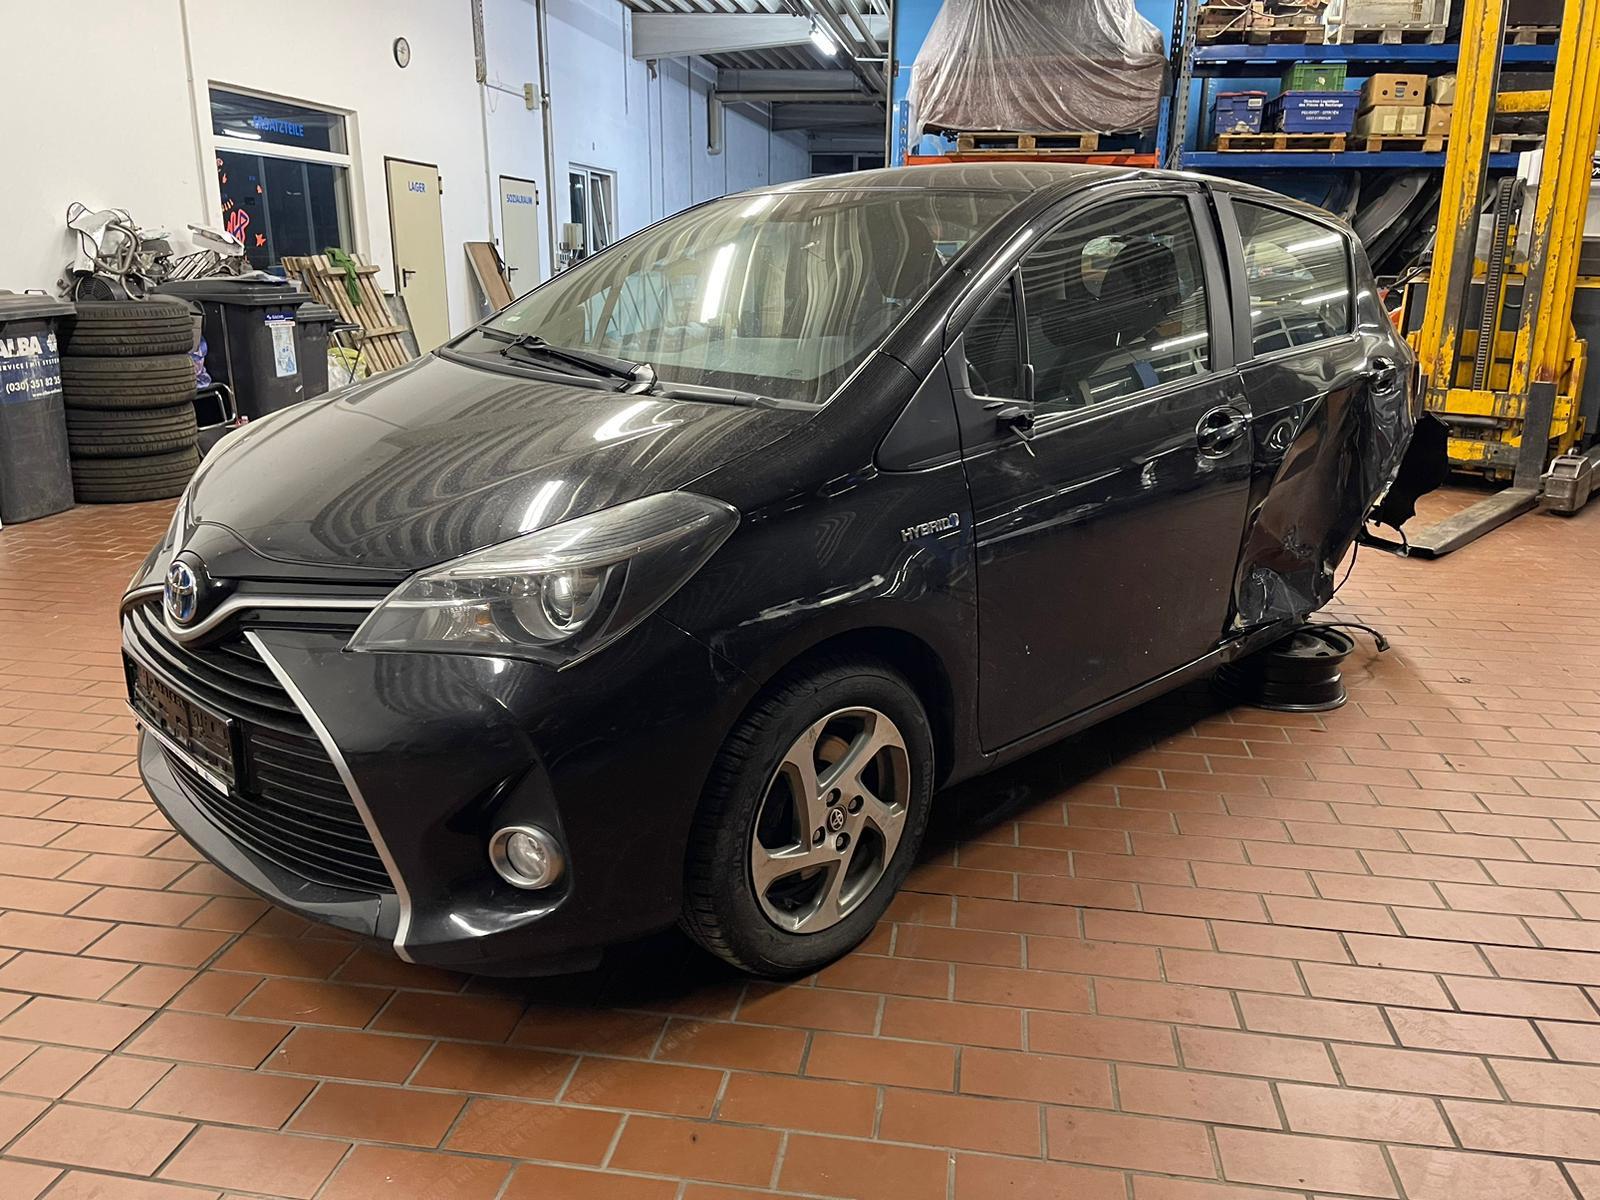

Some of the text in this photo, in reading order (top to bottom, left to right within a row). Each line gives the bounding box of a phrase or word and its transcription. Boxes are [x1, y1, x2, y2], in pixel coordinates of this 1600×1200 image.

[252, 115, 304, 137] ERSATZTEILE
[408, 181, 426, 192] LAGER
[506, 193, 533, 204] SOZIALRAUM
[0, 335, 43, 358] ALBA
[6, 380, 29, 394] (030)
[30, 379, 44, 389] 351
[45, 377, 54, 386] 82
[901, 517, 951, 542] HYBRID
